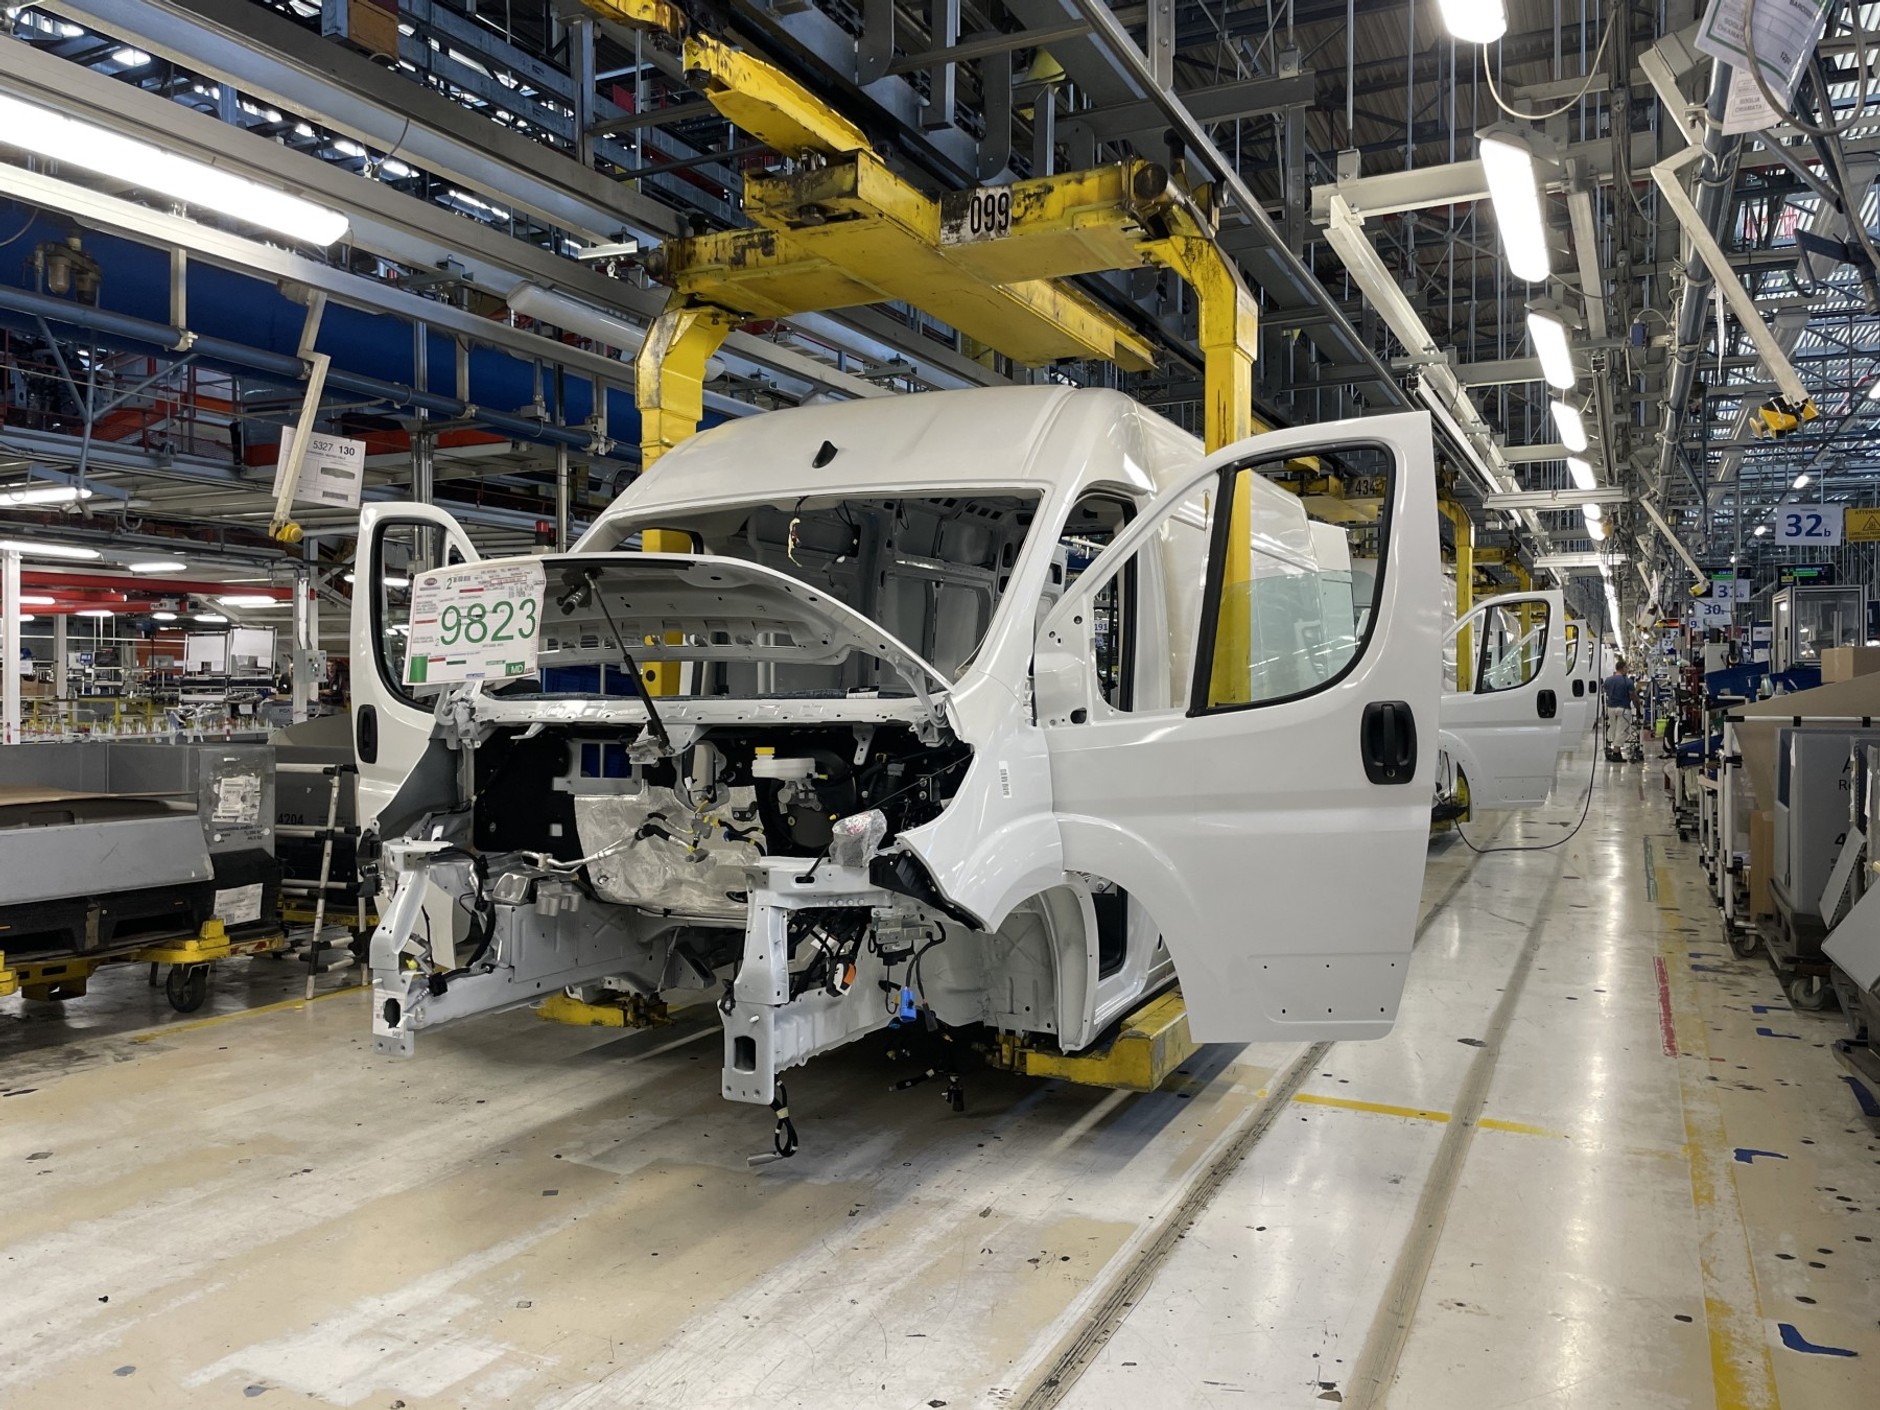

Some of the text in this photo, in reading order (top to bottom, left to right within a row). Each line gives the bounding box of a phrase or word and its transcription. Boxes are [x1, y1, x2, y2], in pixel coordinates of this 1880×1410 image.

[1717, 24, 1744, 41] CHIAMAT
[970, 192, 1009, 234] 099
[312, 440, 334, 452] 5327
[338, 445, 356, 457] 130
[1718, 585, 1745, 598] 3b
[440, 598, 537, 646] 9823
